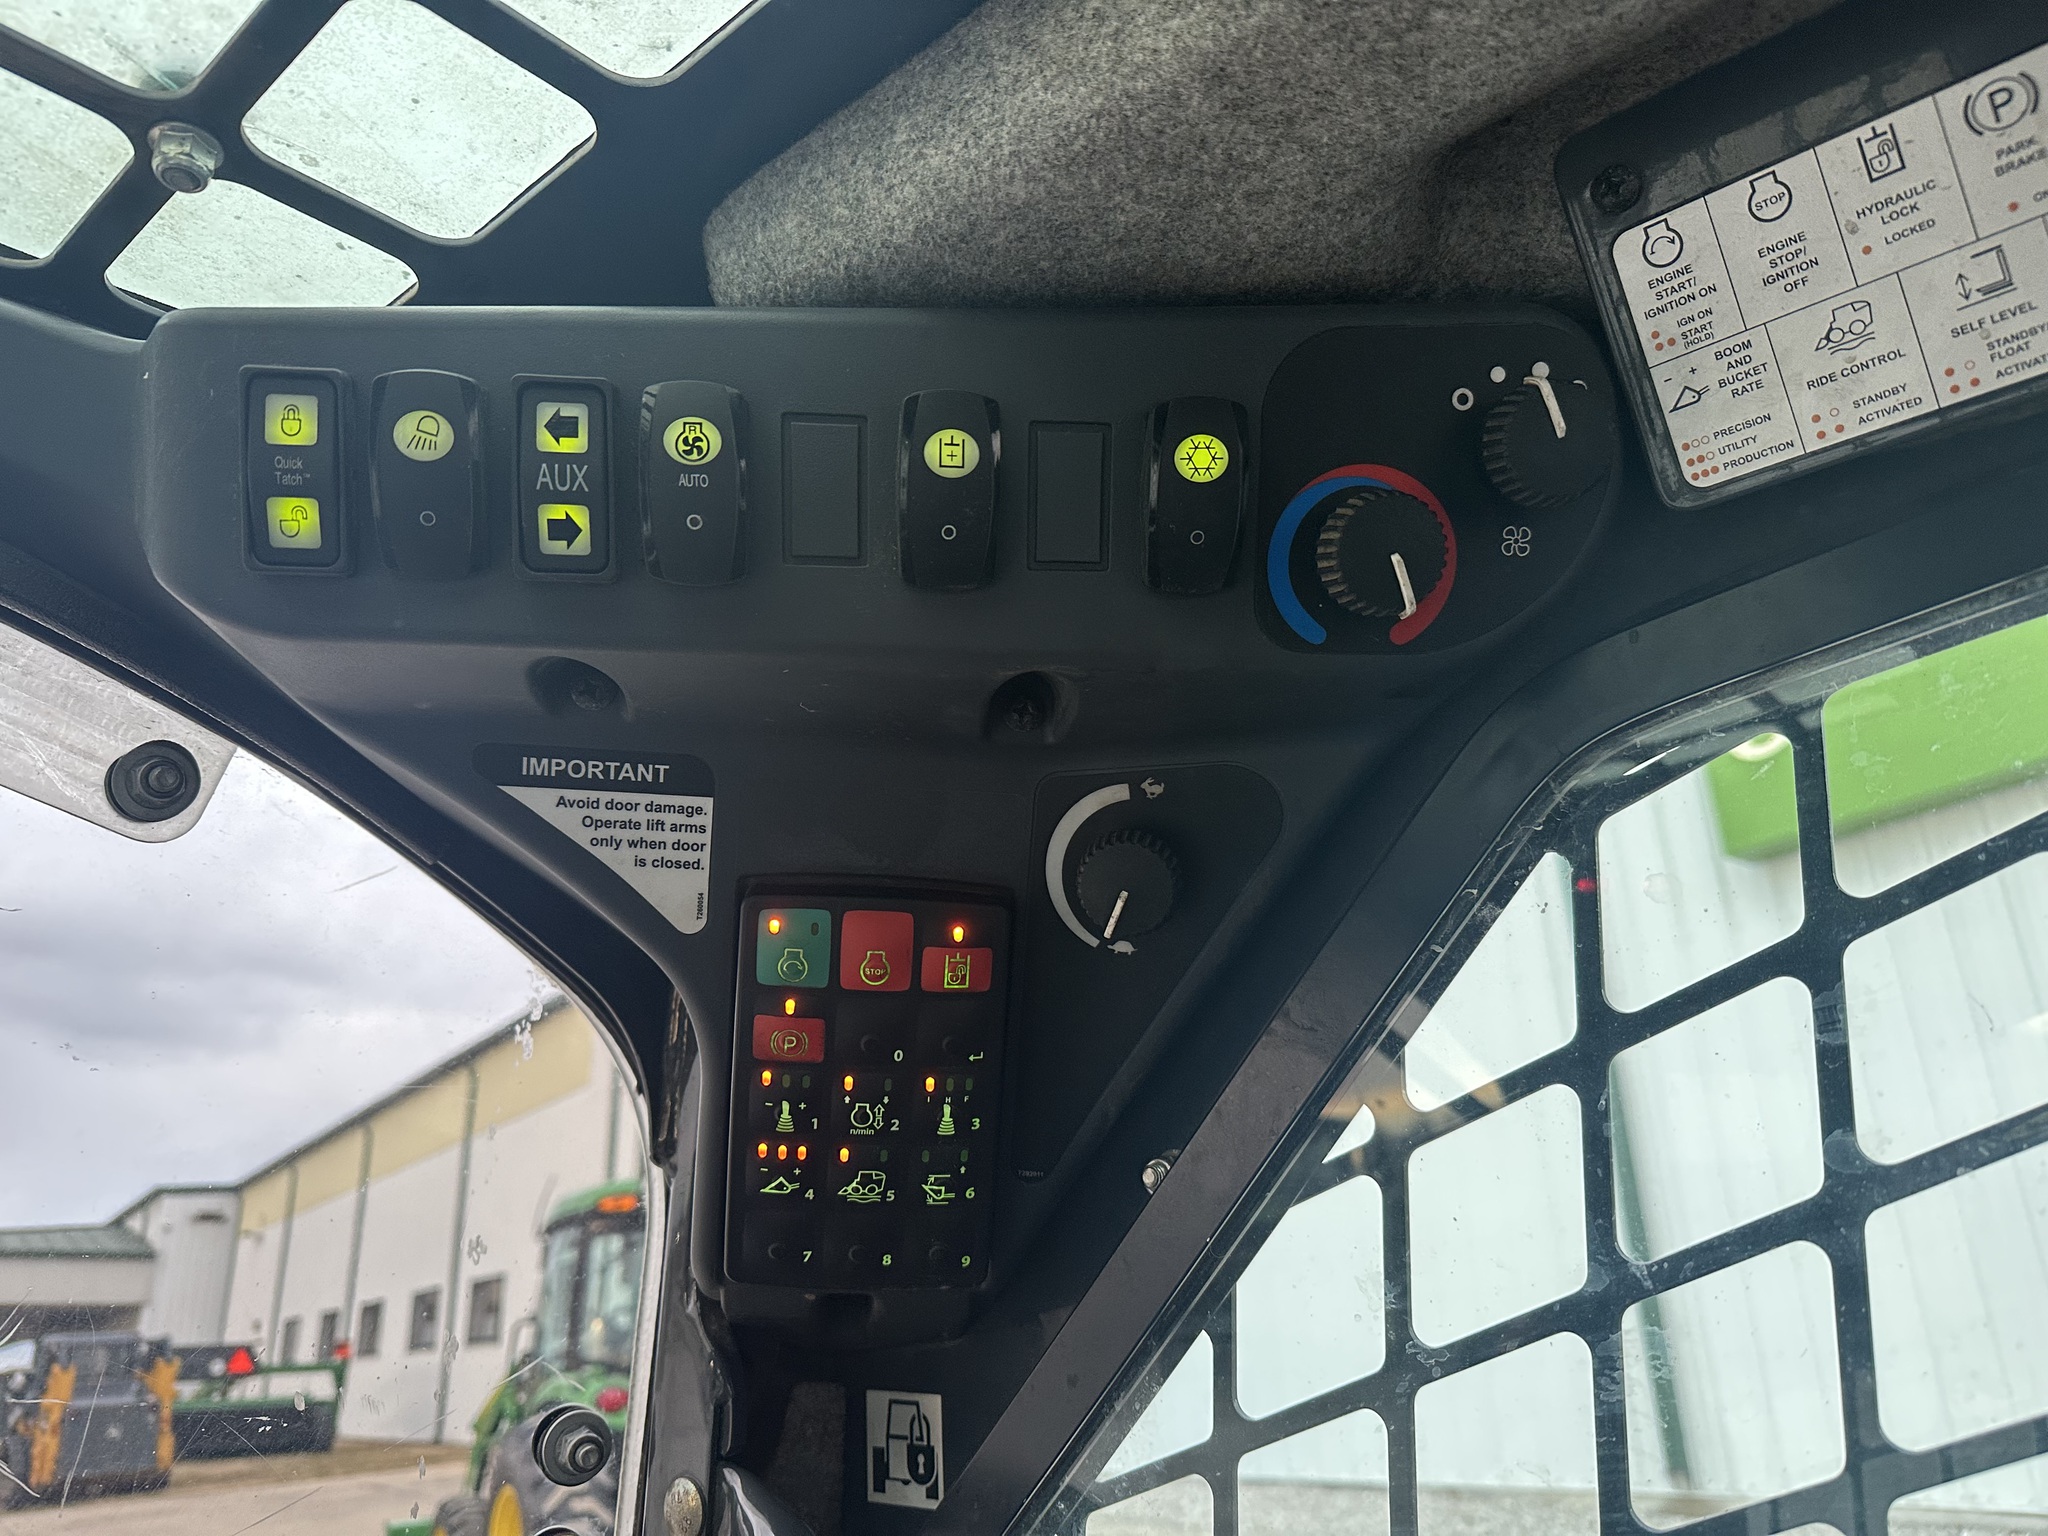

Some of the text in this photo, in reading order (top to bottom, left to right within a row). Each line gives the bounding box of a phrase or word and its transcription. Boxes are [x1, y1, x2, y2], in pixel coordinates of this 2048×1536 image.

[1995, 136, 2039, 160] PARK
[1994, 147, 2048, 177] BRAKE
[1754, 191, 1786, 211] STOP
[1855, 179, 1936, 220] HYDRAULIC
[1881, 202, 1921, 225] LOCK
[1884, 218, 1936, 245] LOCKED
[1757, 231, 1808, 259] ENGINE
[1768, 246, 1807, 269] STOP/
[1648, 264, 1693, 289] ENGINE
[1762, 257, 1819, 287] IGNITION
[1655, 277, 1697, 301] START/
[1783, 276, 1809, 293] OFF
[1644, 283, 1717, 320] IGNITION ON
[1676, 307, 1713, 328] IGN ON
[1951, 301, 2038, 338] SELF LEVEL
[1681, 320, 1714, 340] START
[1684, 332, 1715, 350] (HOLD)
[1714, 339, 1753, 361] BOOM
[1989, 341, 2031, 363] FLOAT
[1726, 354, 1752, 371] AND
[1806, 349, 1906, 391] RIDE CONTROL
[1718, 362, 1768, 389] BUCKET
[1731, 379, 1765, 398] RATE
[1852, 383, 1907, 409] STANDBY
[1858, 396, 1923, 426] ACTIVATED
[1713, 413, 1771, 440] PRECISION
[1718, 435, 1757, 455] UTILITY
[274, 456, 303, 469] Quick
[1723, 440, 1795, 471] PRODUCTION
[536, 464, 589, 492] AUX
[678, 473, 709, 487] AUTO
[521, 756, 670, 783] IMPORTANT
[556, 795, 708, 818] Avoid door damage.
[582, 815, 707, 834] Operate lift arms
[590, 836, 707, 852] only when door
[634, 855, 705, 871] is closed.
[865, 967, 888, 976] STOP
[783, 1036, 797, 1053] P
[894, 1049, 904, 1062] 0
[811, 1118, 818, 1130] 1
[850, 1127, 875, 1136] n/min
[890, 1119, 900, 1131] 2
[971, 1118, 981, 1130] 3
[805, 1189, 815, 1200] 4
[886, 1190, 896, 1202] 5
[965, 1187, 975, 1199] 6
[803, 1251, 813, 1262] 7
[882, 1254, 892, 1266] 8
[961, 1255, 971, 1267] 9
